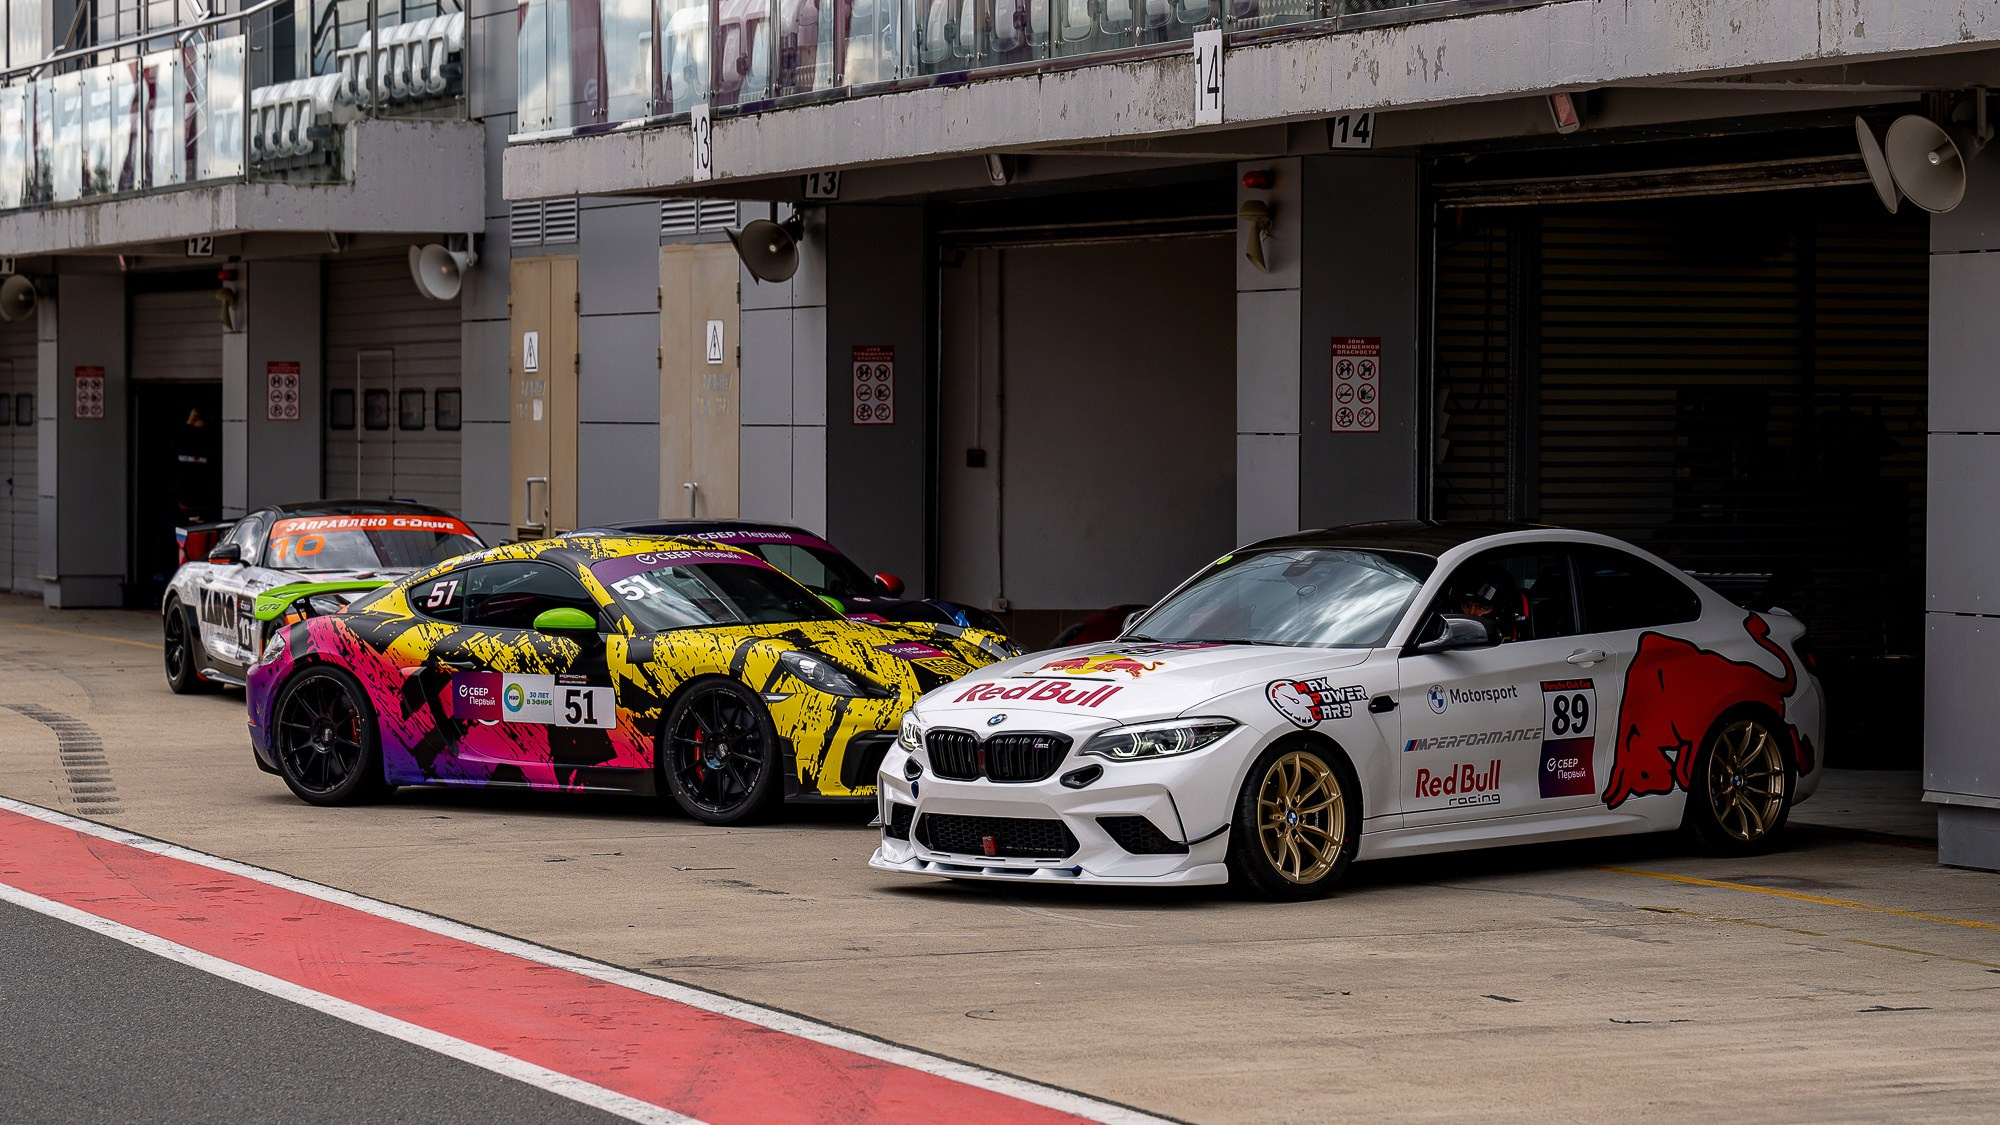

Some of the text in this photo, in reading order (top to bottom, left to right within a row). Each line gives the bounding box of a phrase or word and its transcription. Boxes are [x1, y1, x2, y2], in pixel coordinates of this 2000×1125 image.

[1196, 45, 1220, 111] 14
[1337, 112, 1370, 144] 14
[693, 116, 710, 170] 13
[809, 171, 837, 195] 13
[190, 237, 211, 254] 12
[286, 518, 387, 532] ЗАПРАВЛЕНО
[699, 530, 791, 540] СБЕР Первый
[271, 535, 325, 560] 10
[656, 550, 742, 560] СБЕР Первый
[426, 580, 459, 608] 51
[611, 574, 664, 601] 51
[258, 603, 282, 612] GT4
[468, 687, 489, 696] СБЕР
[529, 691, 537, 699] 30
[953, 680, 1124, 708] Red Bull
[1291, 678, 1331, 694] MAX
[1450, 685, 1518, 704] Motorsport
[469, 696, 496, 706] Первый
[531, 698, 552, 706] ЭФИРЕ
[1308, 686, 1367, 705] POWER
[565, 689, 598, 725] 51
[1308, 702, 1352, 720] CARS
[1552, 693, 1590, 736] 89
[1557, 758, 1579, 769] СБЕР
[1416, 759, 1502, 798] Red Bull
[1557, 767, 1586, 780] Первый
[1449, 793, 1501, 806] racing
